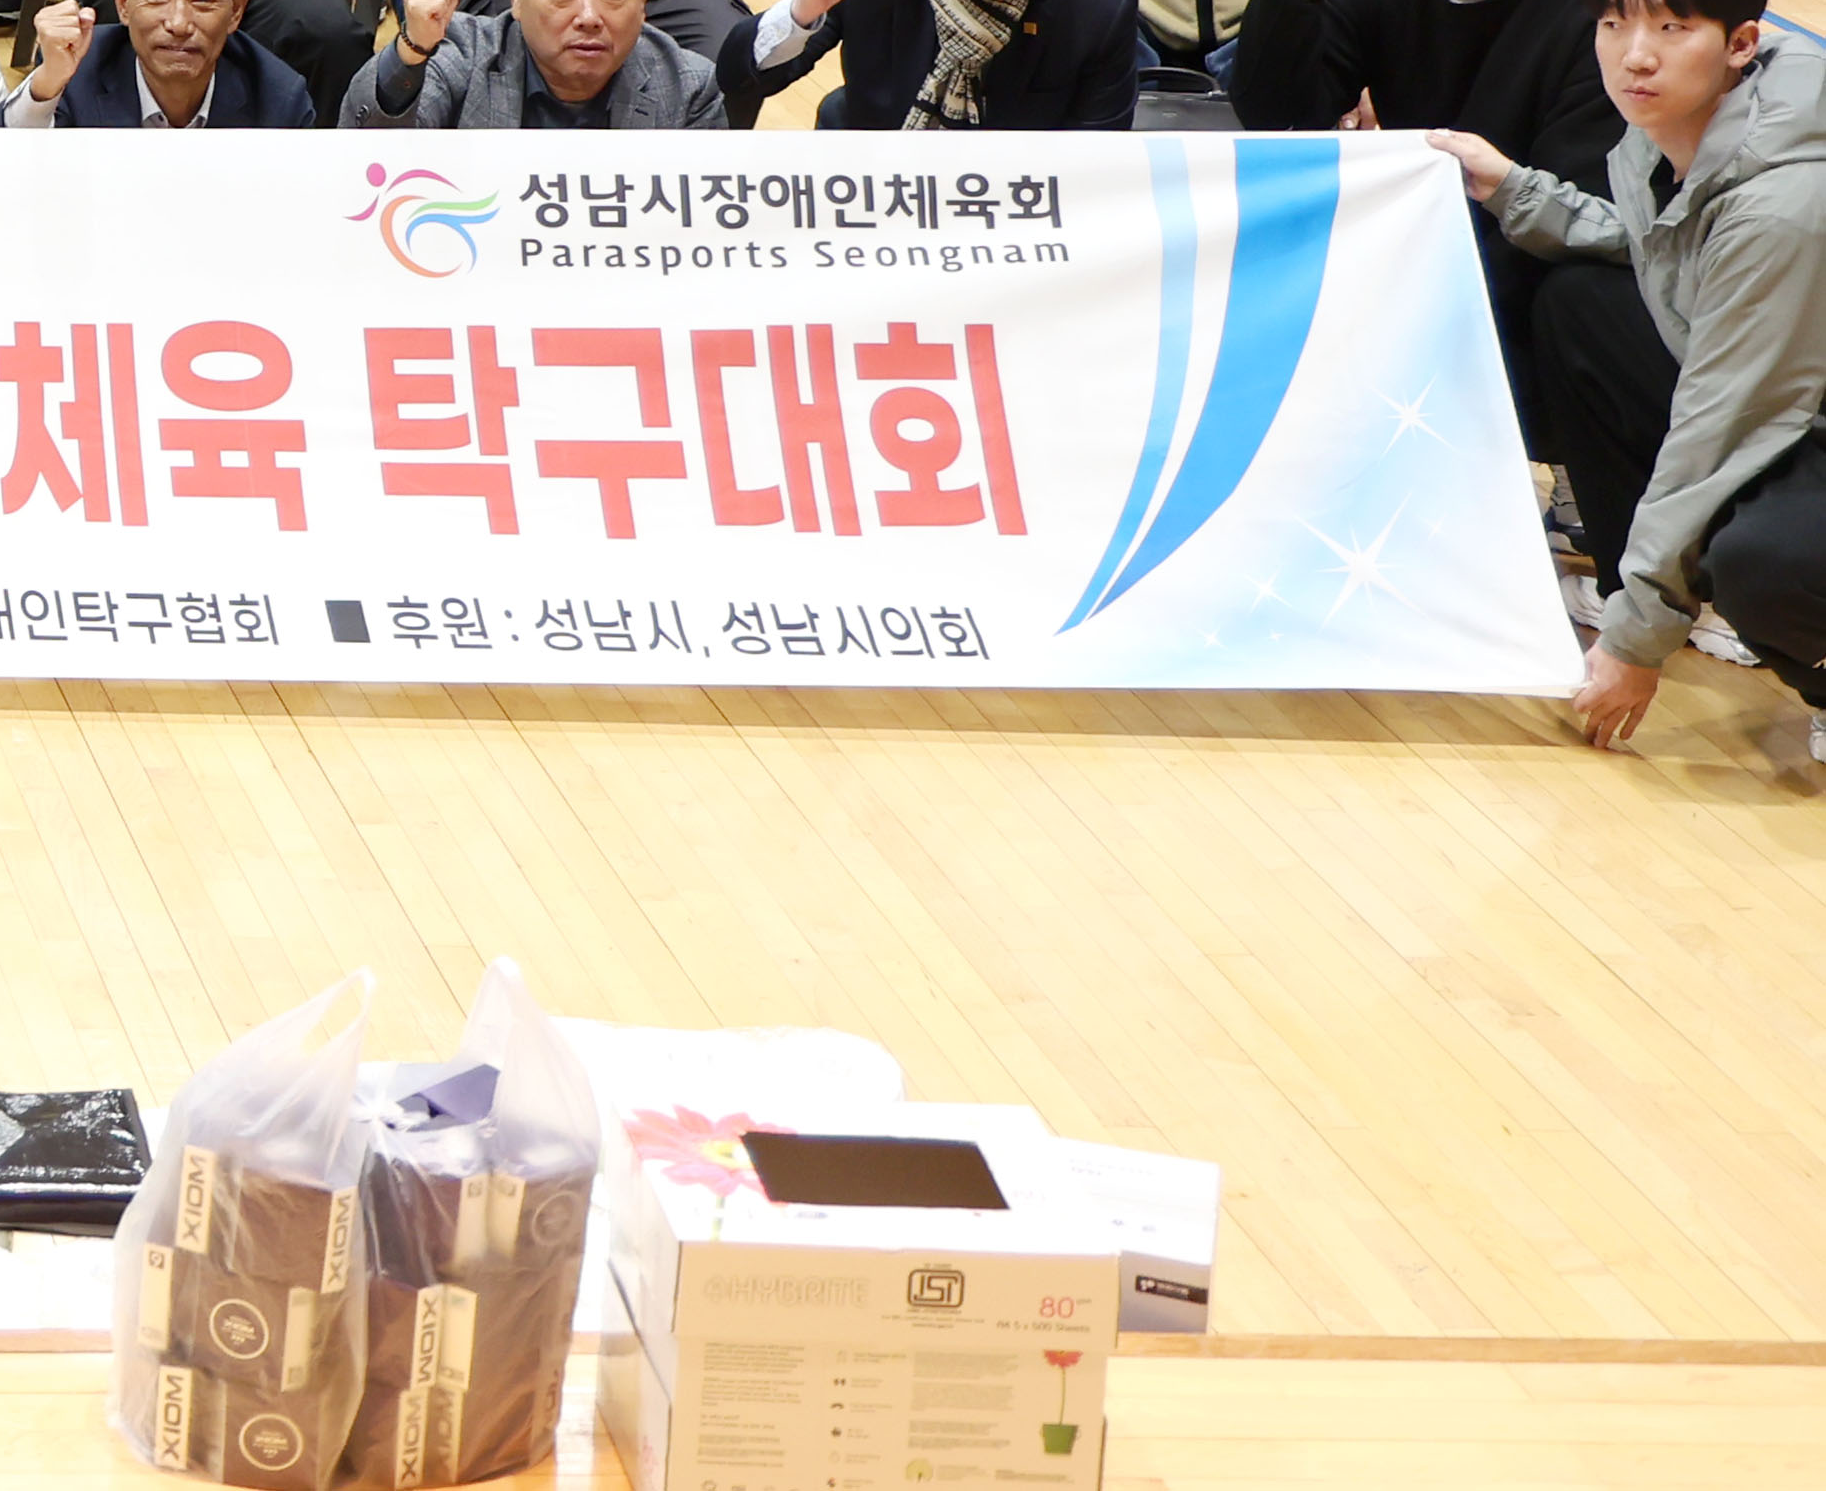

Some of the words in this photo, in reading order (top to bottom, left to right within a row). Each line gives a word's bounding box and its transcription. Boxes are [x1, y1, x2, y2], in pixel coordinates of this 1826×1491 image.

[519, 173, 1063, 230] 성남시장애인체육회
[520, 238, 788, 275] Parasports
[814, 240, 1070, 272] Seongnam
[363, 321, 1029, 540] 탁구대회
[721, 603, 992, 659] 성남시의회
[181, 1154, 208, 1243] XIOM
[328, 1192, 352, 1287] XIOM
[417, 1297, 439, 1386] XIOM
[1039, 1296, 1075, 1319] 80
[161, 1374, 185, 1462] XIOM
[400, 1396, 425, 1483] XIOM
